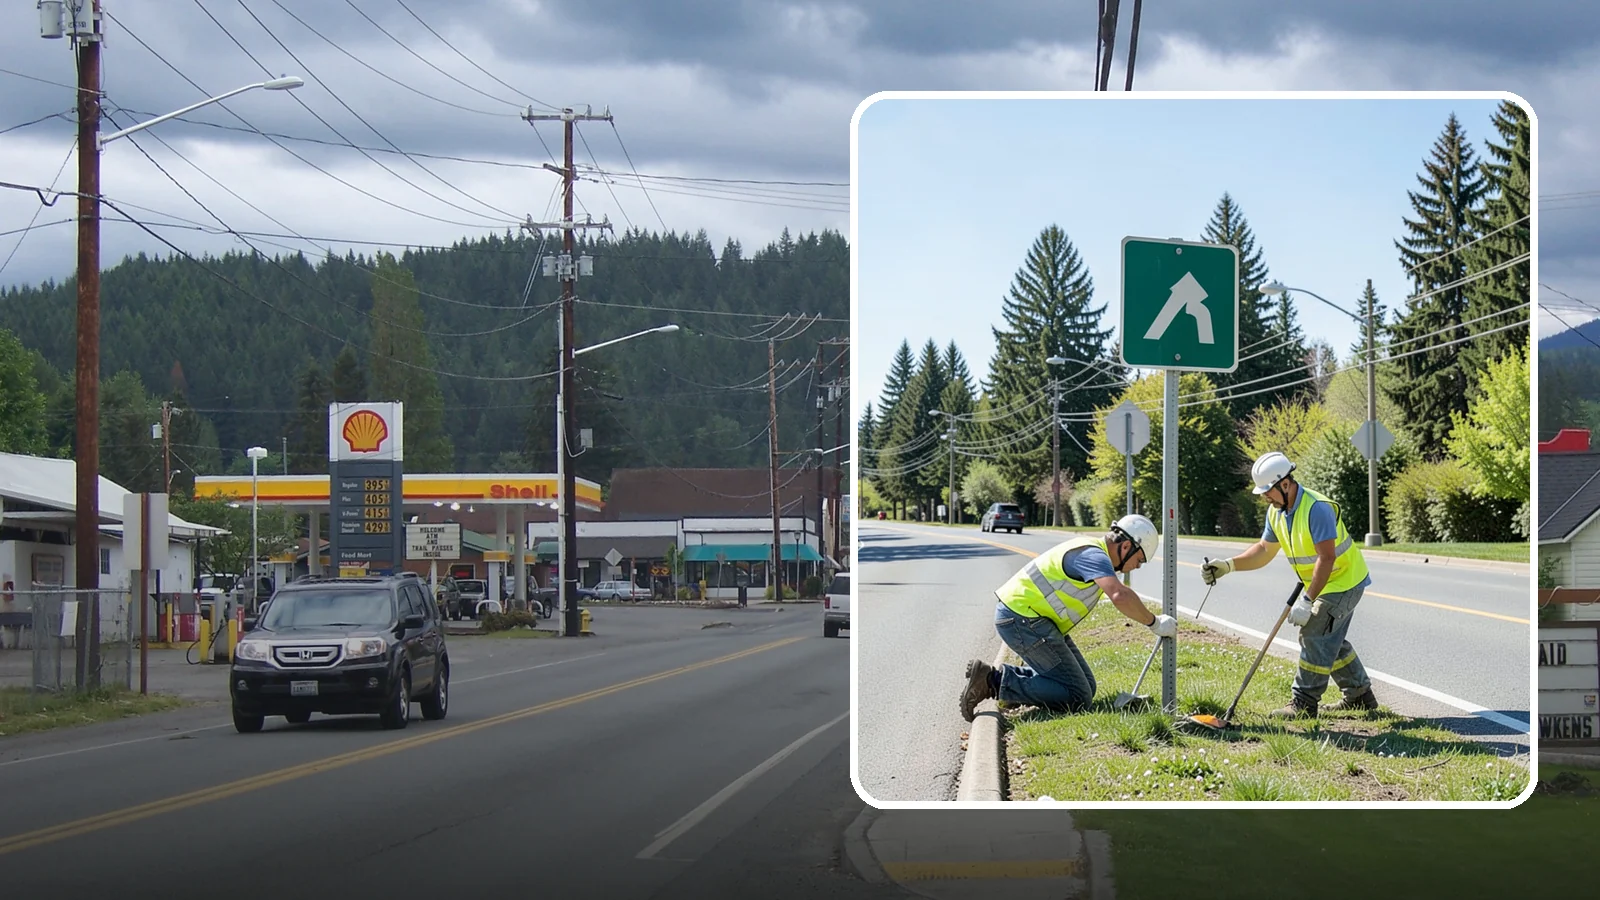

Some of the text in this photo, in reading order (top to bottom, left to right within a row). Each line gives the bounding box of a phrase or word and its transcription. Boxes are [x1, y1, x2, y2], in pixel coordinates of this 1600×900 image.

[365, 480, 384, 490] 395
[490, 484, 547, 499] Shell
[365, 494, 384, 504] 405
[365, 508, 384, 518] 415
[365, 522, 384, 532] 429
